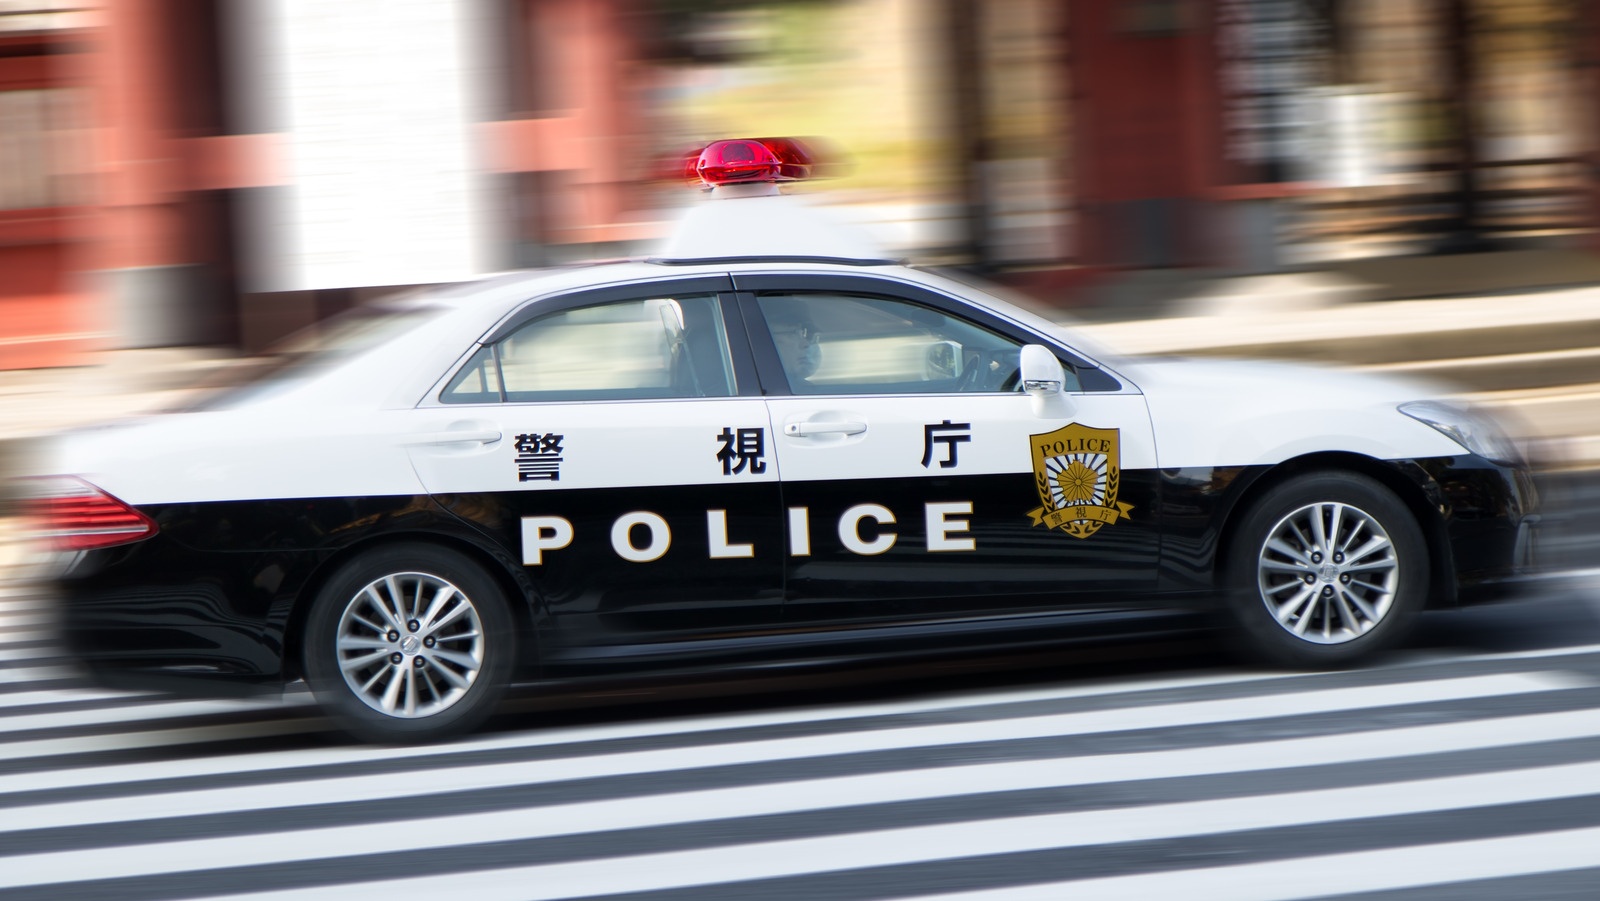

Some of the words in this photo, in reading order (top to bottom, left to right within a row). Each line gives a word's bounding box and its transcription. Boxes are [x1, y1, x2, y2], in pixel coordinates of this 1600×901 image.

[514, 420, 971, 481] 警視庁
[1041, 438, 1110, 457] POLICE
[521, 502, 977, 565] POLICE
[1051, 507, 1111, 525] 警視庁
